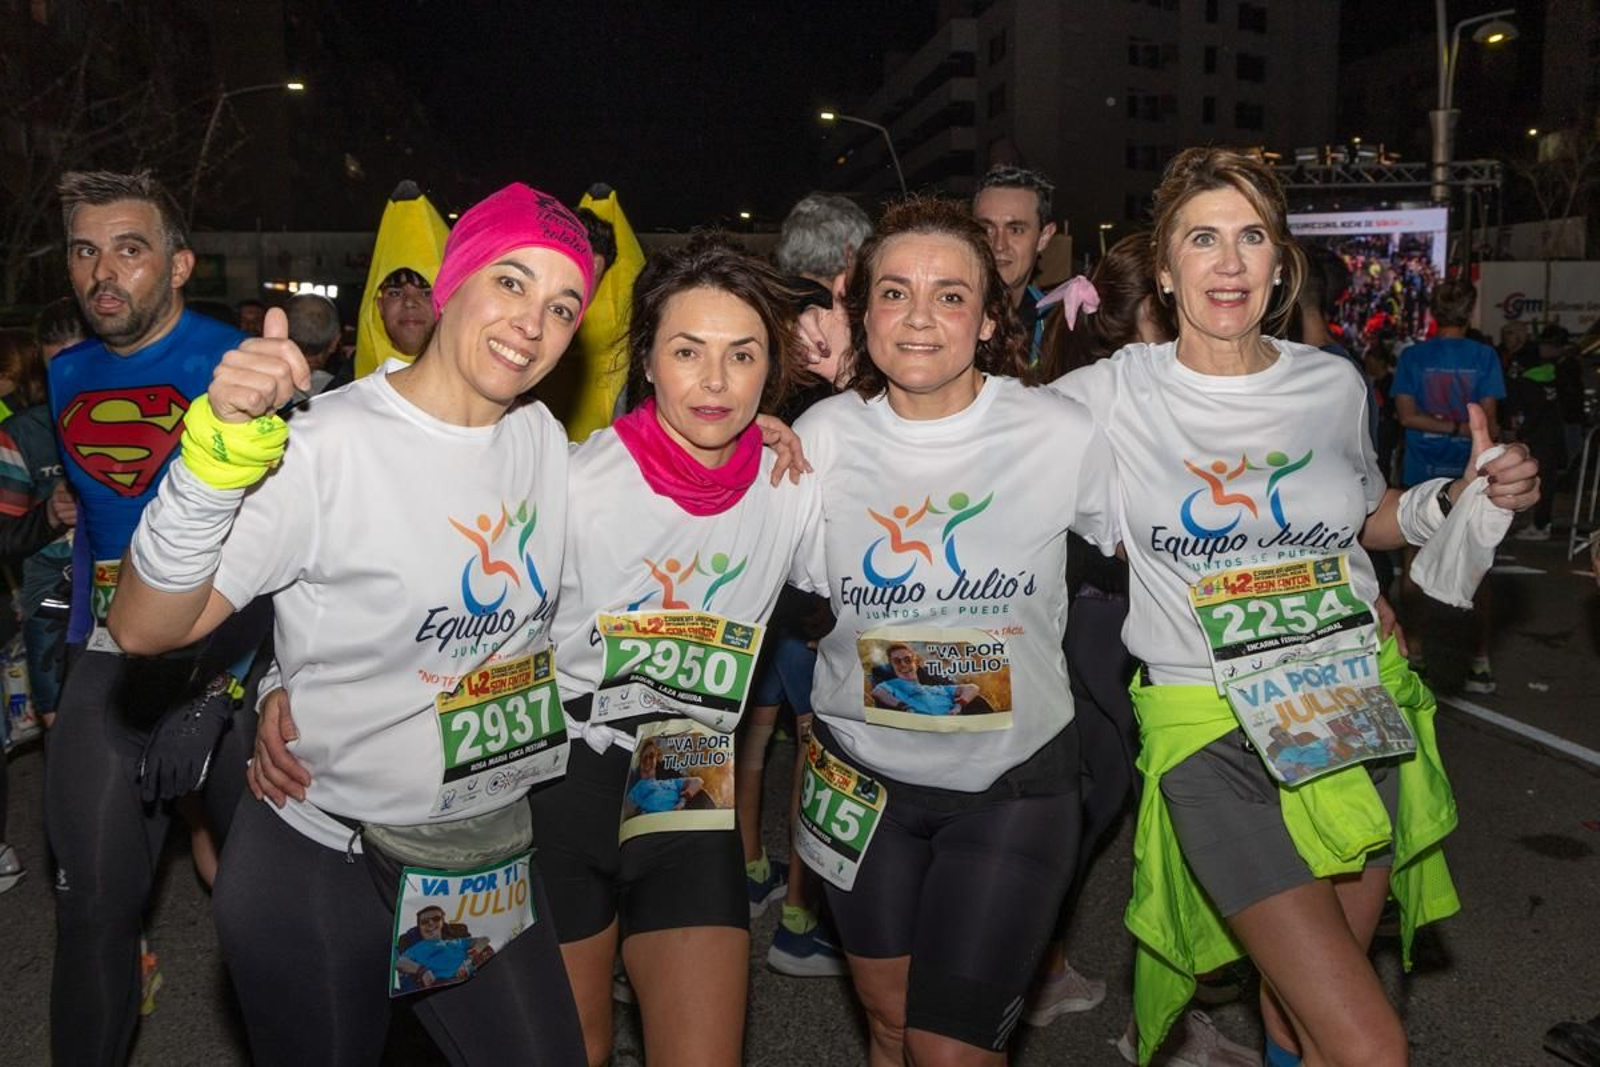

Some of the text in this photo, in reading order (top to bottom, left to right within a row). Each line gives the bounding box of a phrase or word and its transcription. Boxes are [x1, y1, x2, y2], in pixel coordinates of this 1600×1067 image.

[1151, 526, 1248, 563] Equipo
[1251, 553, 1267, 564] SE
[840, 576, 925, 616] Equipo
[866, 604, 1010, 620] JUNTOS SE PUEDE
[415, 605, 515, 653] Equipo
[1212, 590, 1353, 645] 2254
[452, 642, 500, 658] JUNTO
[613, 639, 738, 695] 2950
[927, 643, 1005, 658] "VA POR
[658, 684, 677, 697] LAZA
[1238, 656, 1371, 707] VA POR TI
[451, 686, 551, 764] 2937
[1273, 686, 1367, 730] JULIO
[668, 735, 730, 752] "VA POR
[470, 760, 487, 771] ROSA
[421, 863, 518, 896] VA POR TI
[448, 878, 527, 924] JULIO
